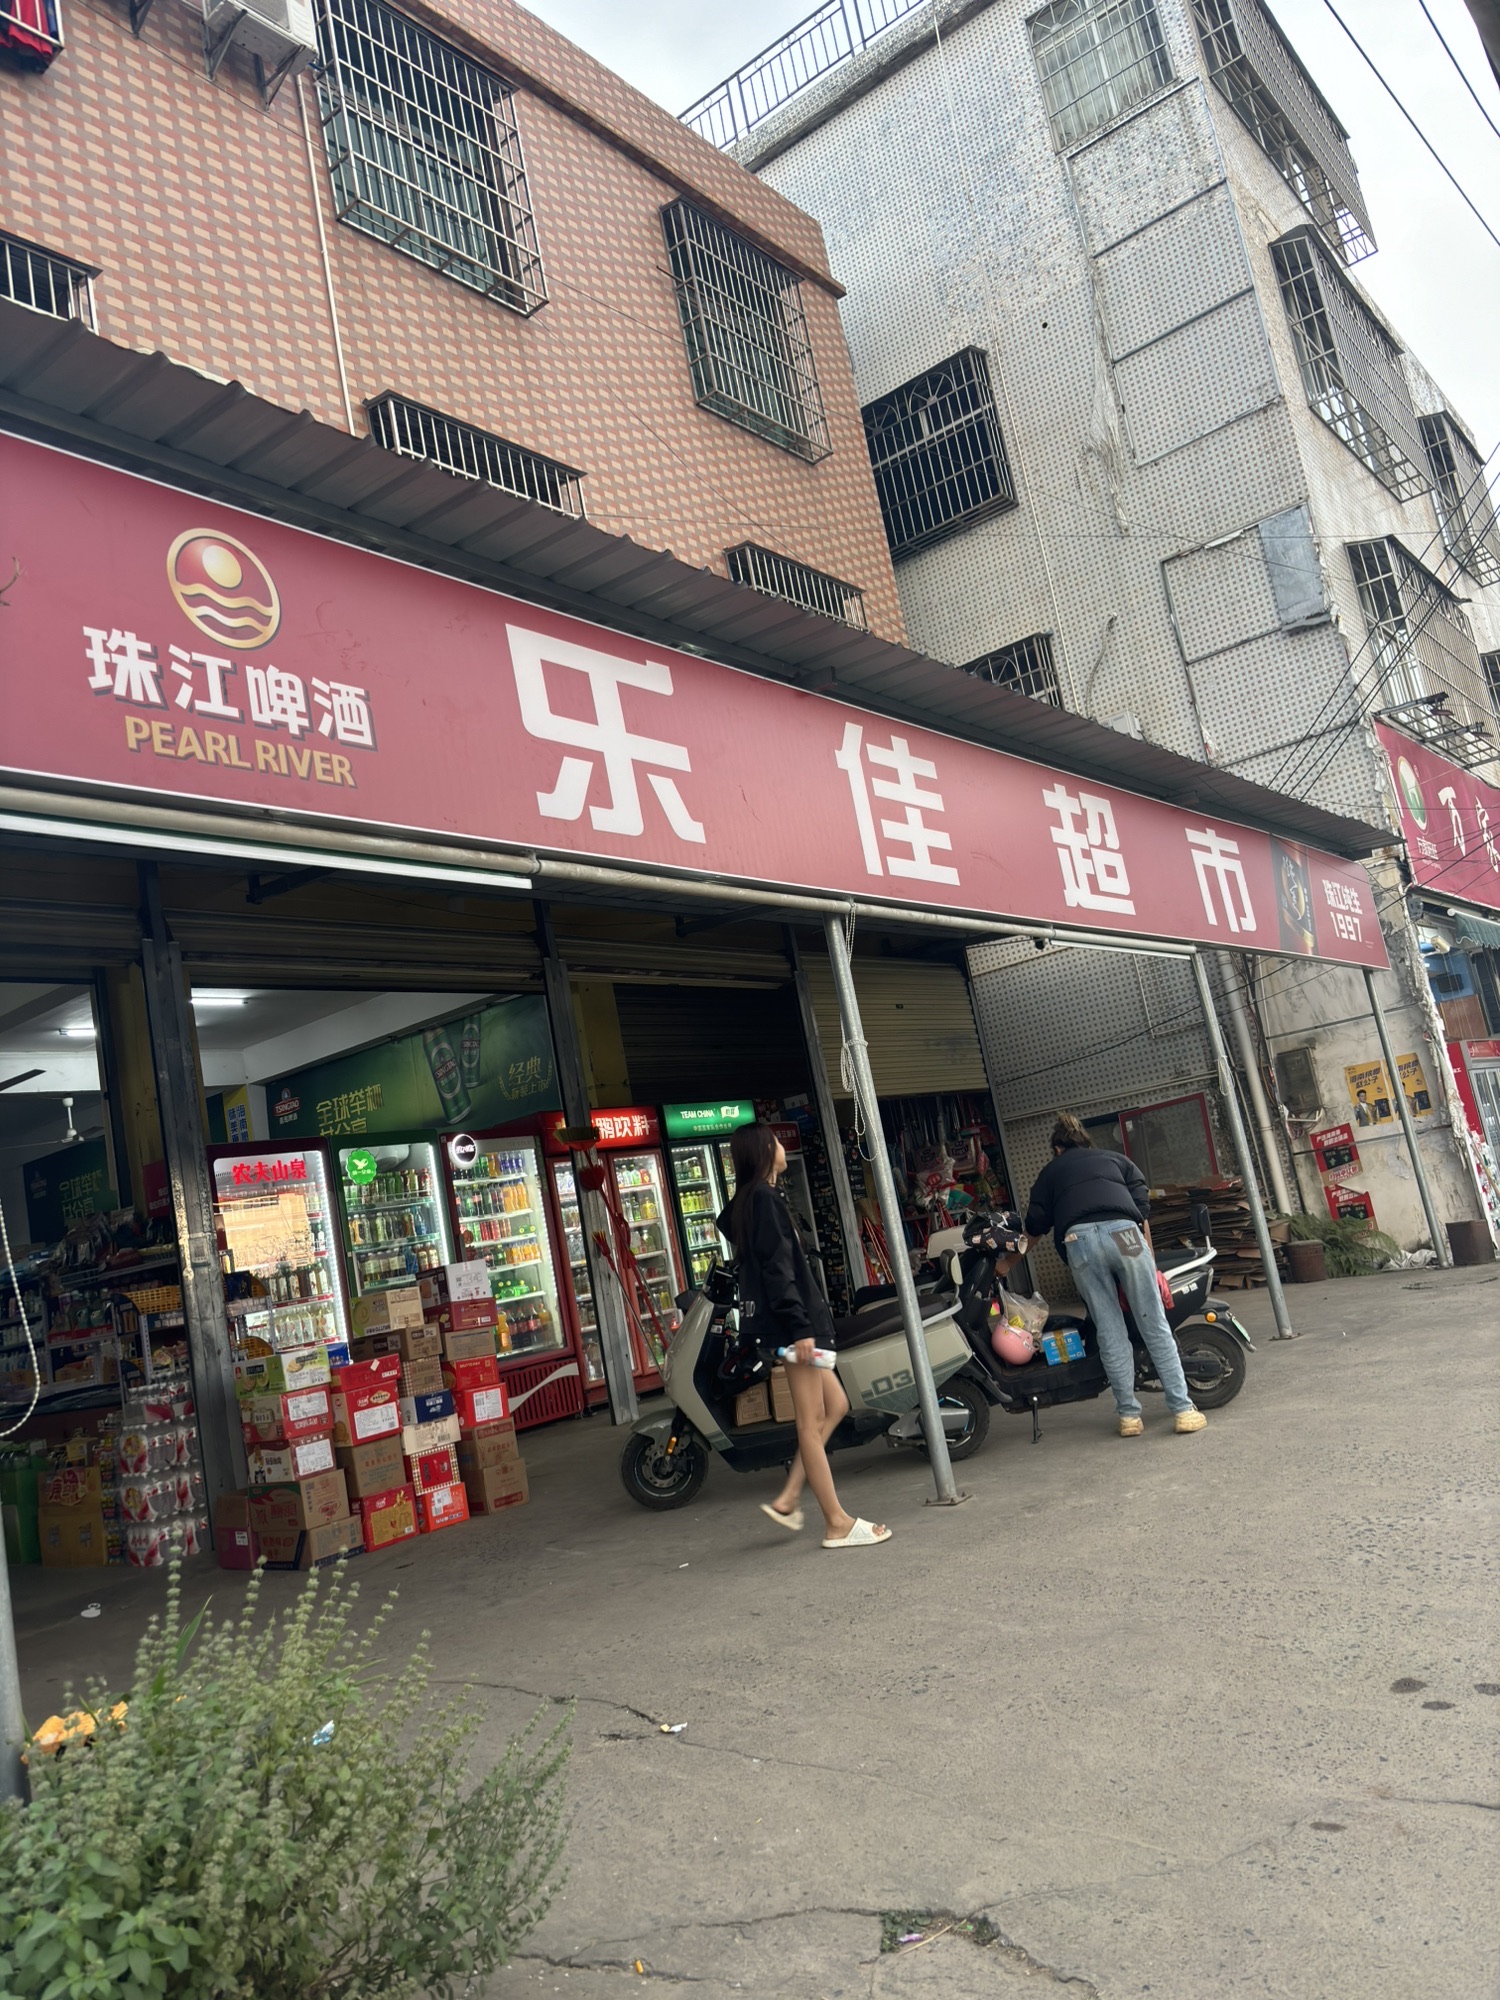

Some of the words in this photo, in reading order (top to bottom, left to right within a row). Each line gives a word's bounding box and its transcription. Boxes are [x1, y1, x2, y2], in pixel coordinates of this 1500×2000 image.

[83, 626, 373, 748] 珠江啤酒
[126, 716, 251, 770] PEARL
[256, 738, 356, 788] RIVER
[505, 623, 1257, 933] 乐佳超市
[1322, 879, 1363, 915] 珠江纯生
[1330, 911, 1362, 943] 1997
[509, 1056, 541, 1086] 经典
[316, 1084, 384, 1127] 全球举杯
[680, 1110, 697, 1120] TEAM
[697, 1109, 716, 1119] CHINA
[592, 1114, 651, 1140] 鹏饮料
[232, 1158, 307, 1185] 农夫山泉
[1119, 1230, 1137, 1246] W
[871, 1369, 914, 1396] 03
